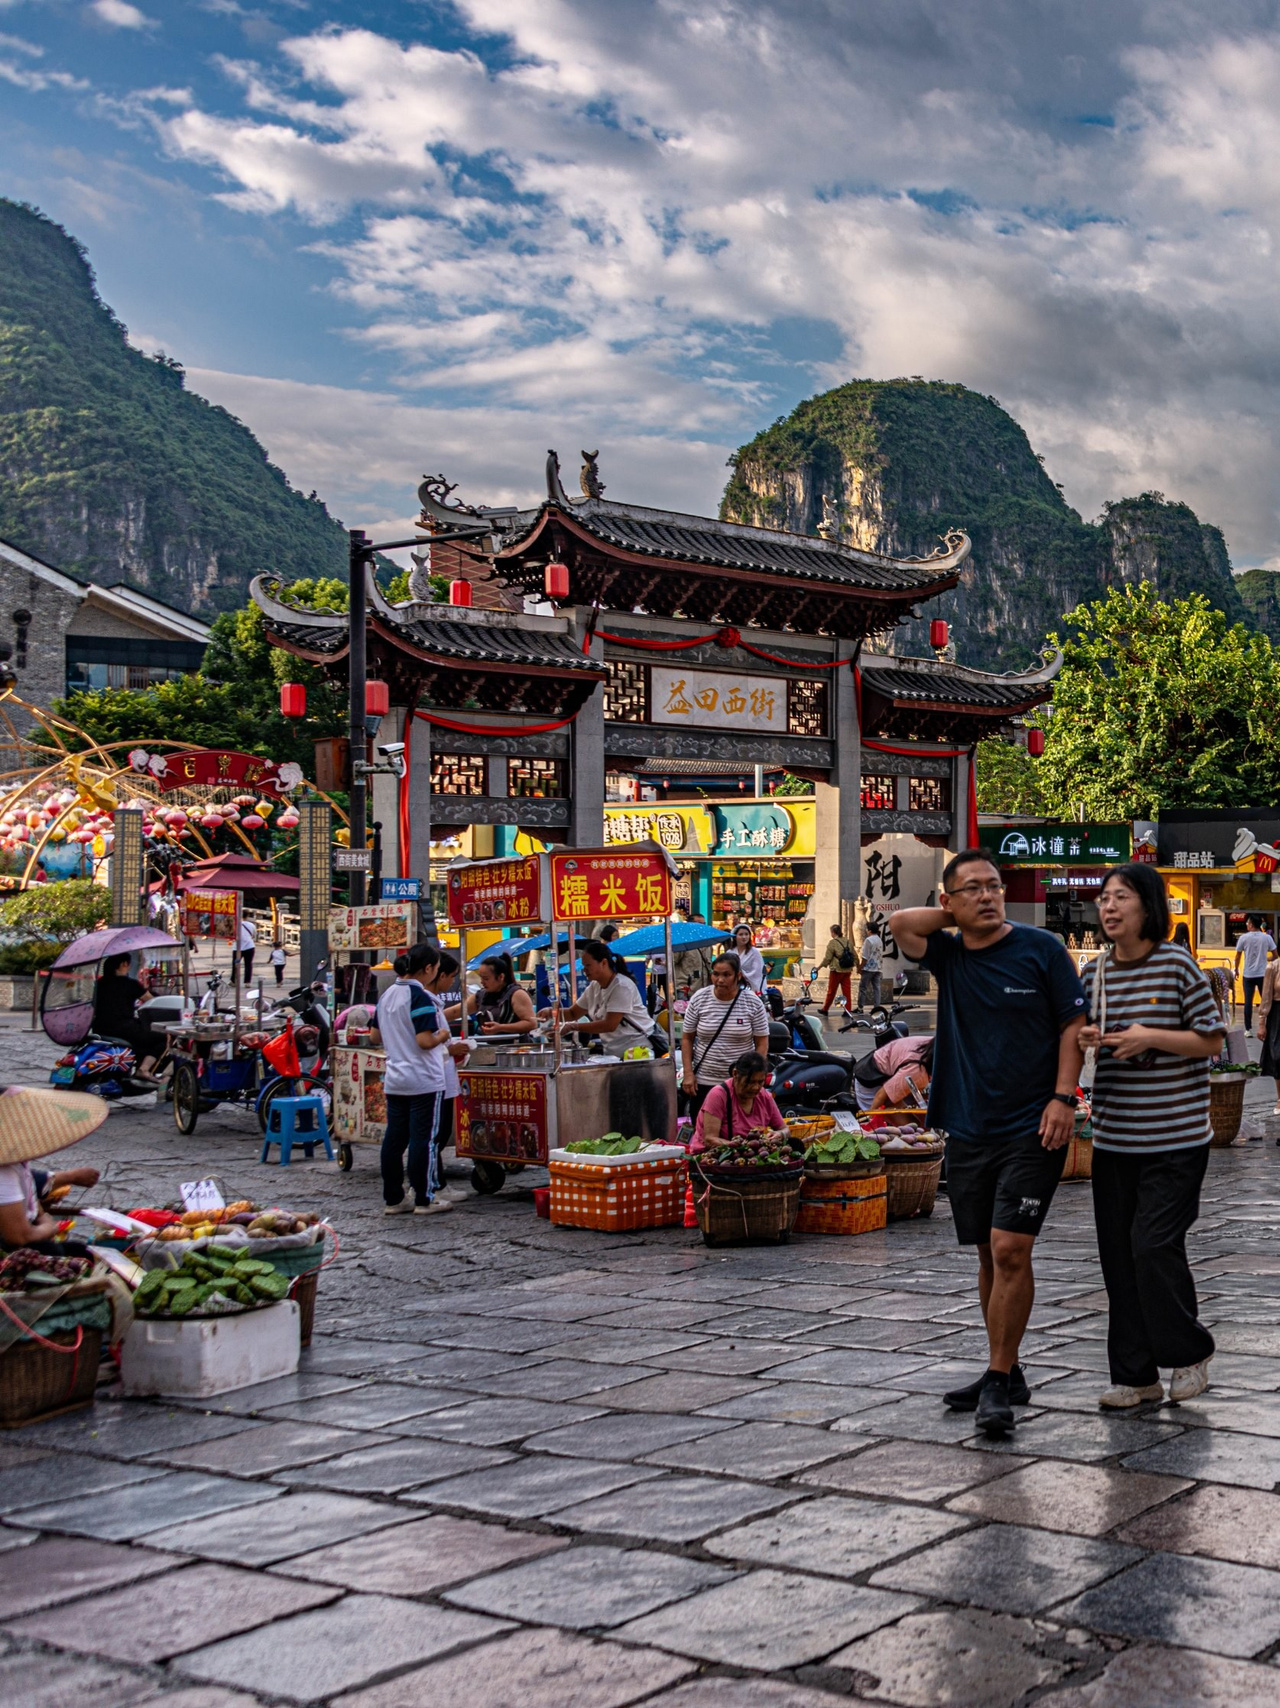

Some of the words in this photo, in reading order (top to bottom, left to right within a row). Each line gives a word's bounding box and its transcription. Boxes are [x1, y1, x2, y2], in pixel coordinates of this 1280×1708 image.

[662, 679, 776, 721] 益田西街
[661, 832, 680, 846] 1928
[719, 826, 788, 850] 手工酥糖
[338, 853, 370, 867] 西街美食城
[1173, 851, 1215, 869] 甜品站
[398, 882, 417, 896] 公厕
[560, 872, 665, 916] 糯米饭
[508, 897, 530, 918] 冰粉
